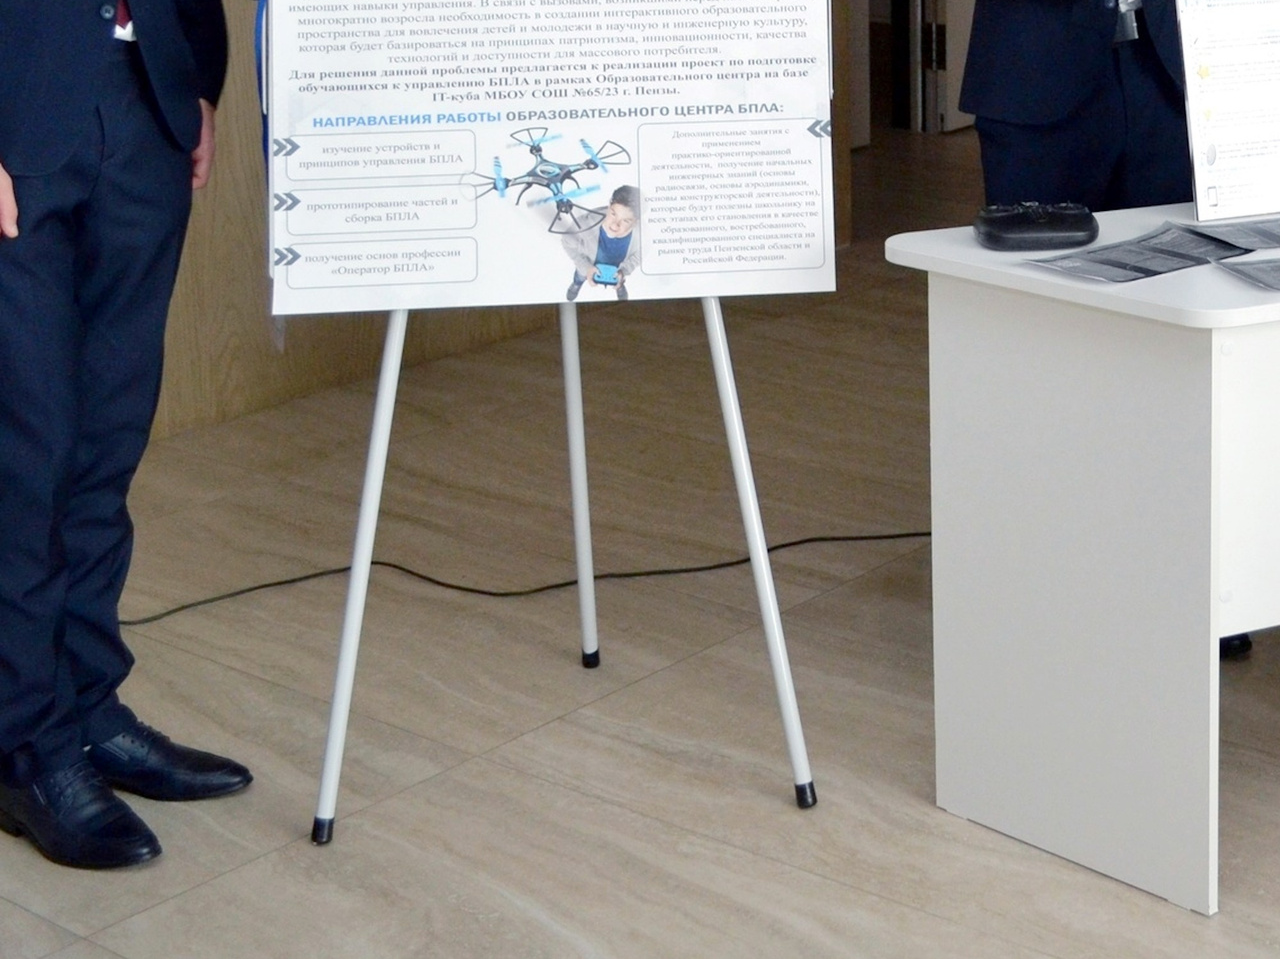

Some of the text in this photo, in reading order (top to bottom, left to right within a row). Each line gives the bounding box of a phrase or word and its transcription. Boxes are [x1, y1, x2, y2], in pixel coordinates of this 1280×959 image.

[312, 103, 783, 127] НАПРАВЛЕНИЯ РАБОТЫ ОБРАЗОВАТЕЛЬНОГО ЦЕНТРА БПЛА:
[322, 145, 372, 155] изучение
[375, 142, 430, 154] устройств
[298, 154, 463, 170] принципов управления БПЛА
[306, 200, 408, 212] прототипирование
[411, 197, 448, 206] частей
[344, 211, 419, 224] сборка БПЛА
[304, 249, 461, 264] получение основ профессии
[331, 262, 434, 276] «Оператор БПЛА»
